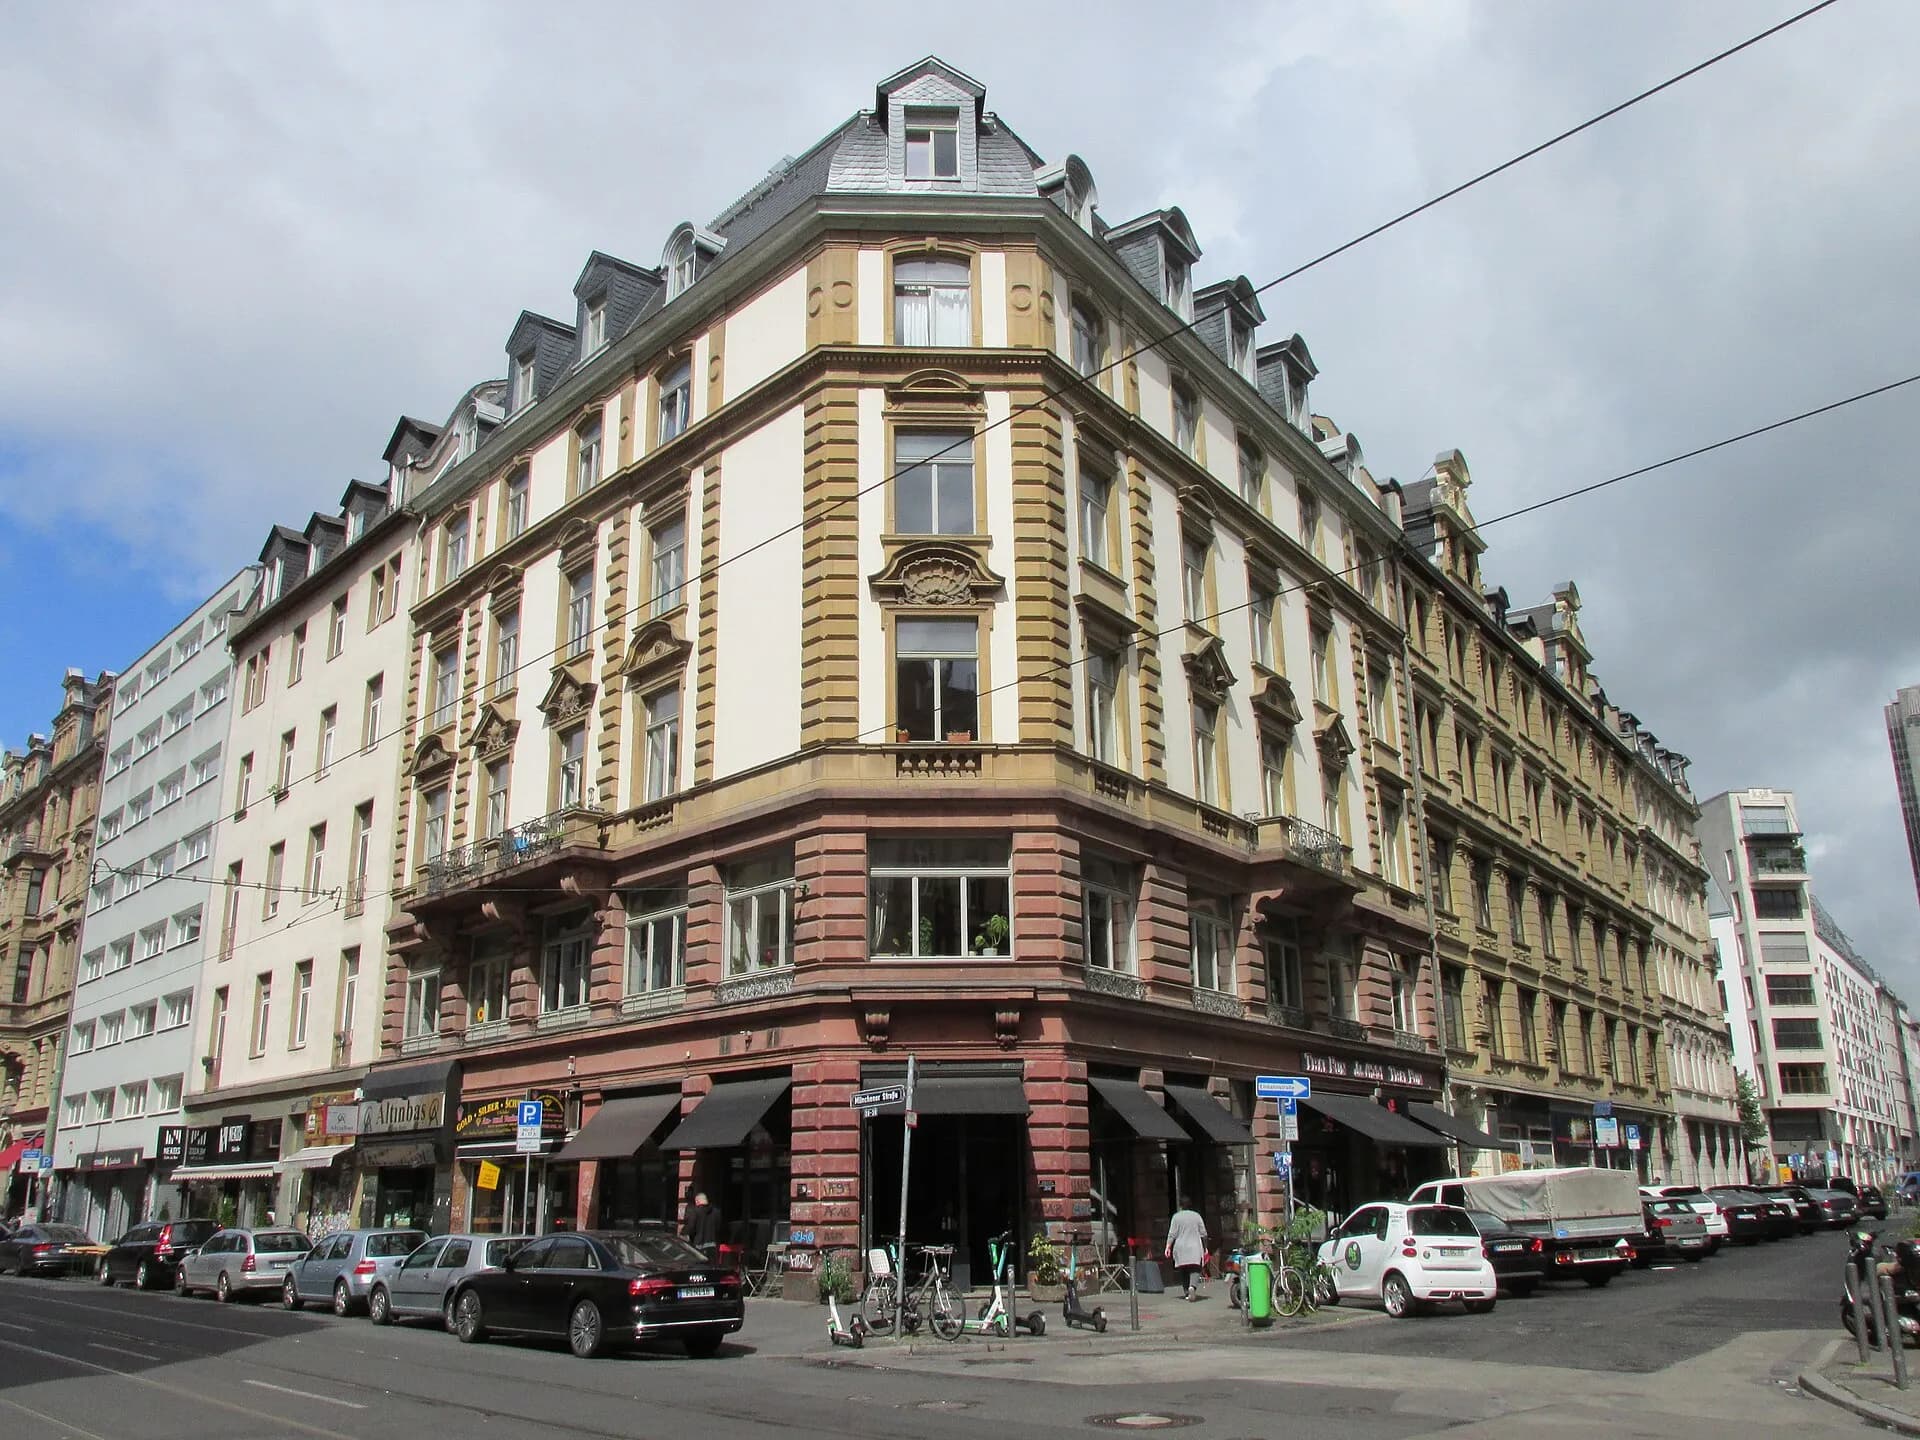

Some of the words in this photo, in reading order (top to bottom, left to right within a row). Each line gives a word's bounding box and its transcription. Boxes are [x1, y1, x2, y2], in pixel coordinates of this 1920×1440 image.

[882, 1091, 898, 1100] Straße
[456, 1114, 473, 1132] GOLD
[478, 1102, 499, 1115] SILBER
[524, 1105, 536, 1123] P
[1628, 1127, 1636, 1138] P
[42, 1156, 51, 1168] P
